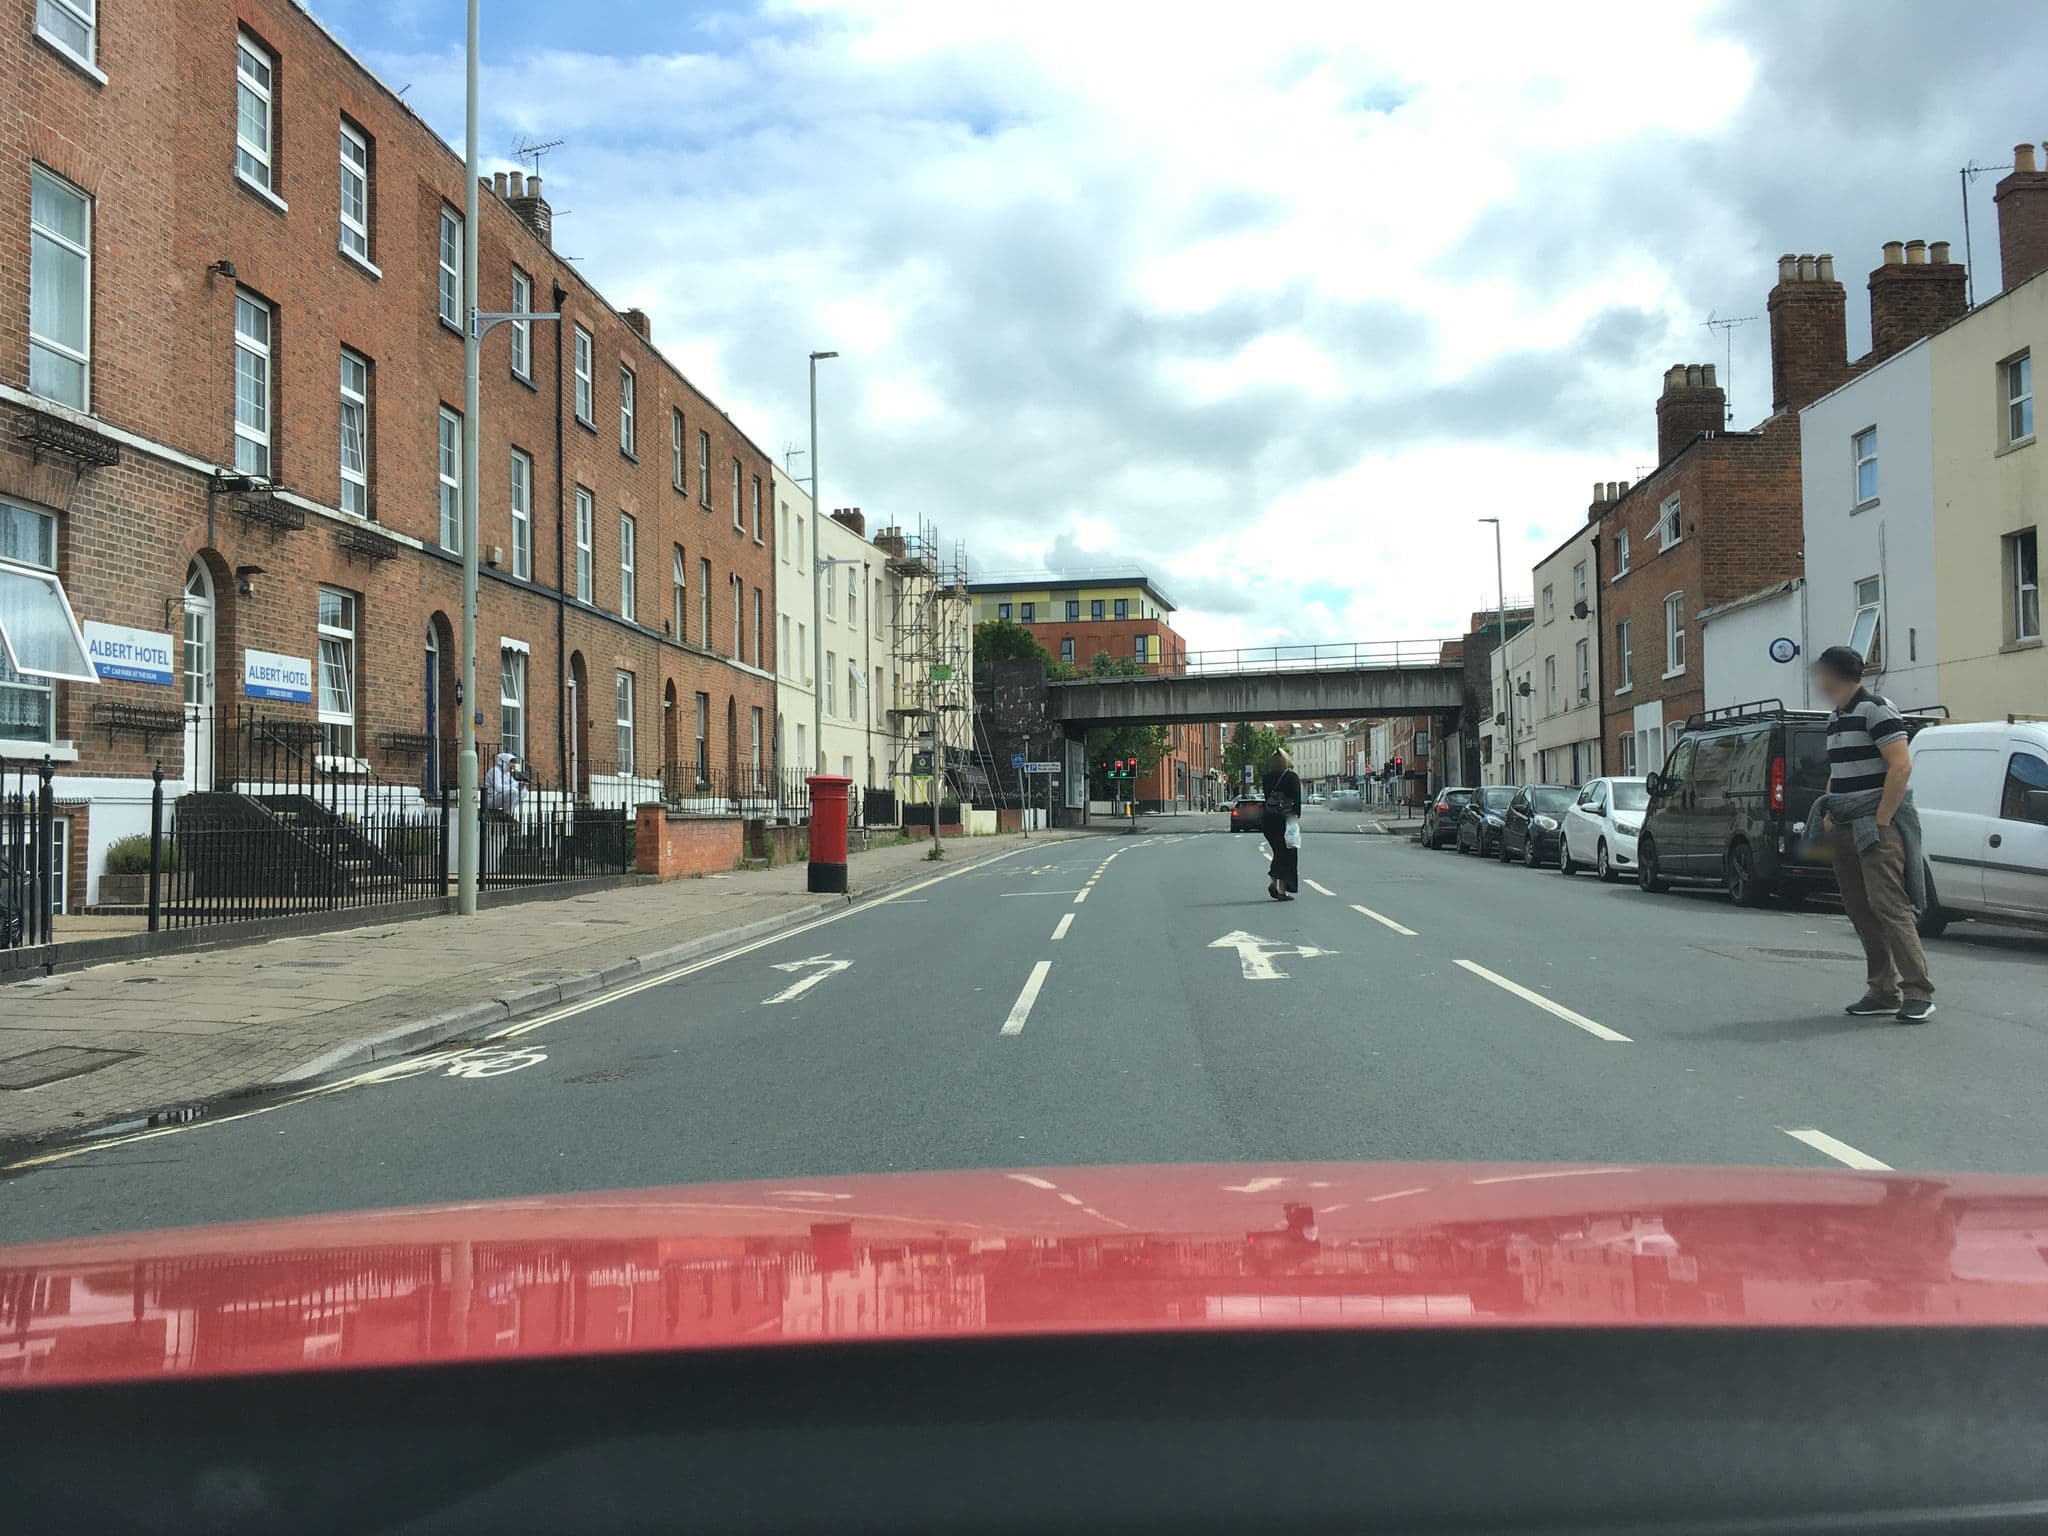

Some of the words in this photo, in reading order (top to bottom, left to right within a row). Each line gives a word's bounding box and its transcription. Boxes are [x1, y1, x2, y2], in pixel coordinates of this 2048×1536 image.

[89, 639, 133, 661] ALBERT
[135, 646, 169, 665] HOTEL
[249, 665, 281, 682] ALBERT
[282, 670, 309, 686] HOTEL
